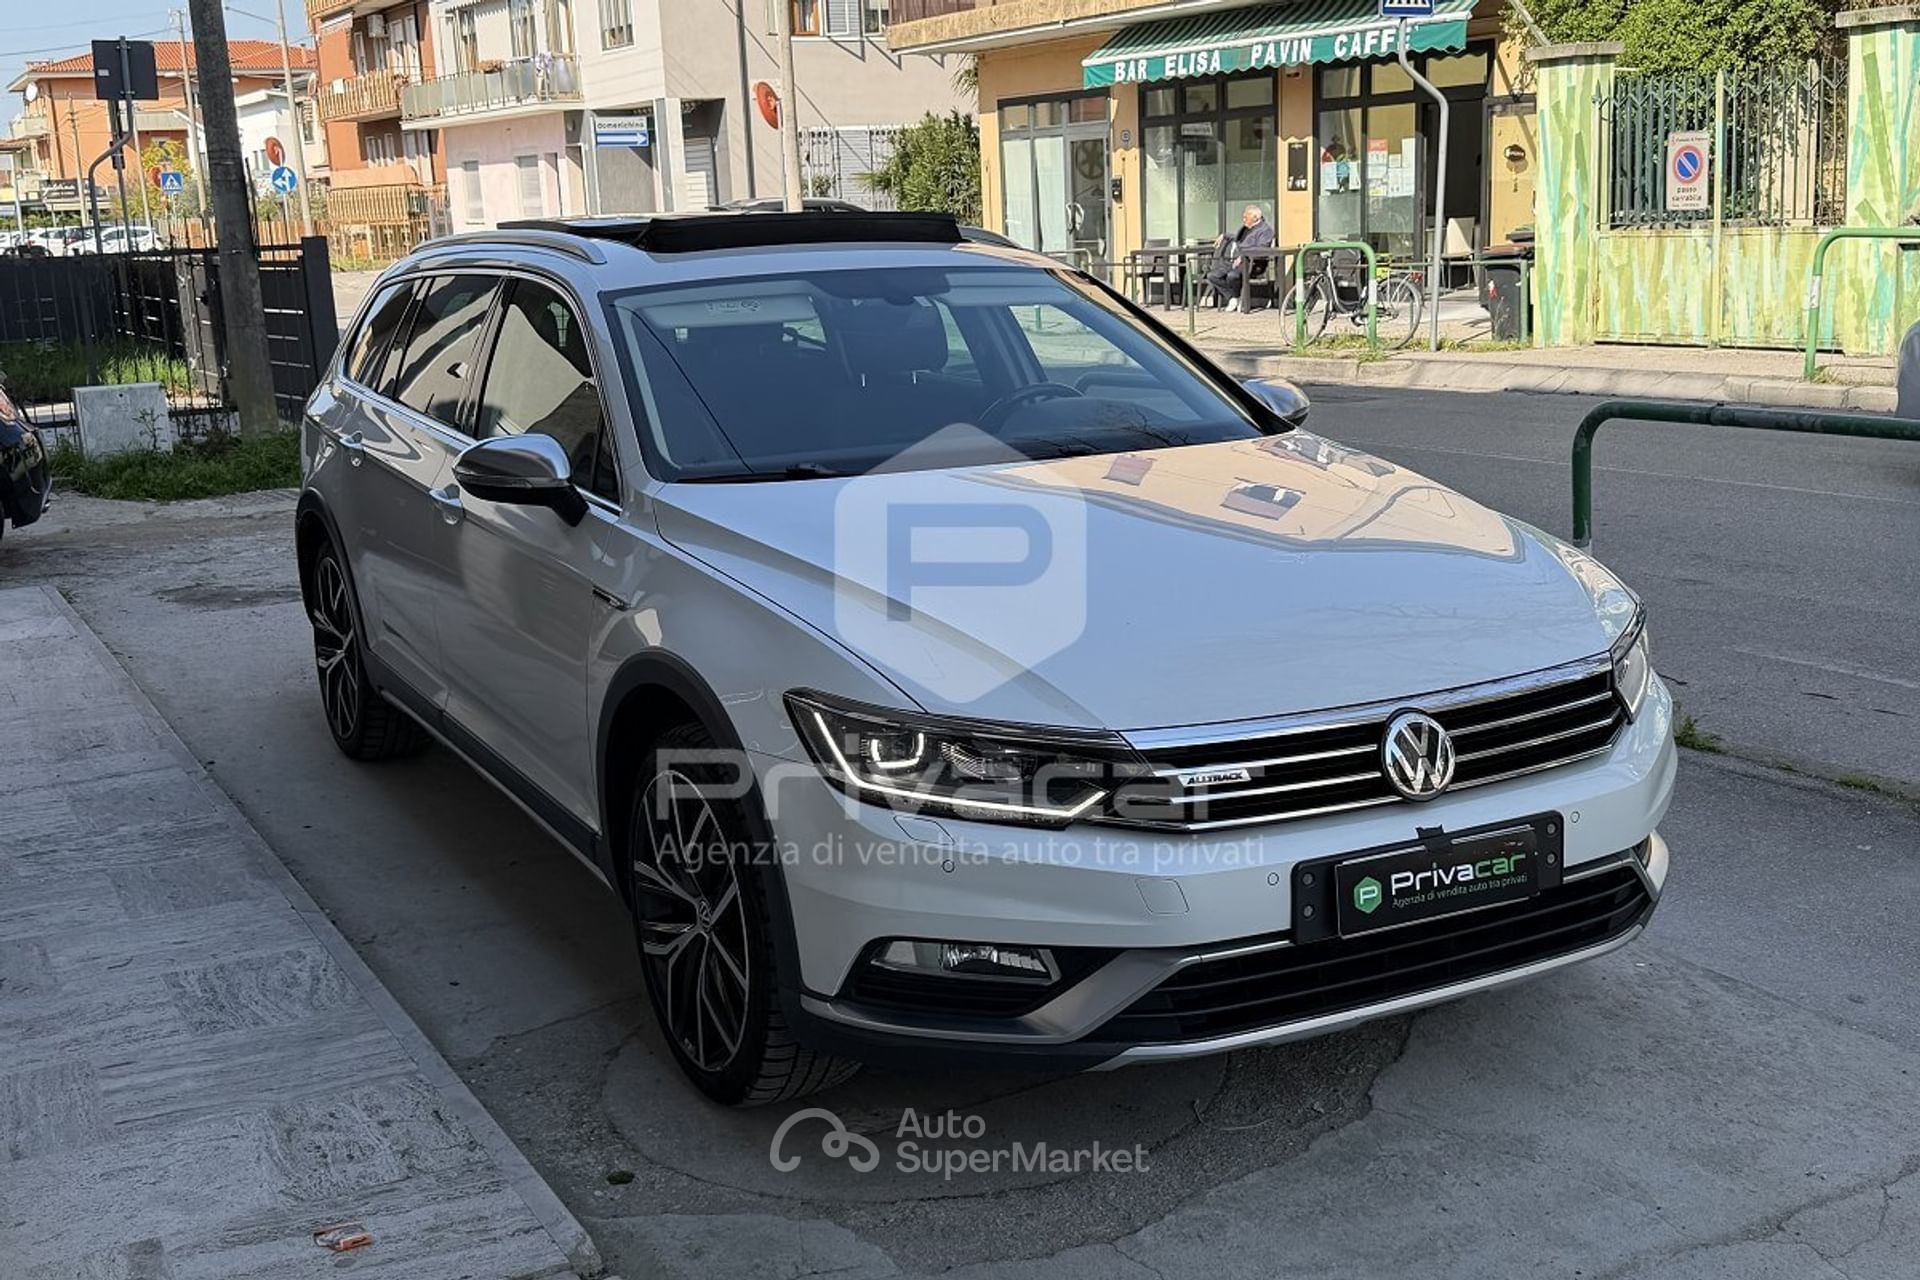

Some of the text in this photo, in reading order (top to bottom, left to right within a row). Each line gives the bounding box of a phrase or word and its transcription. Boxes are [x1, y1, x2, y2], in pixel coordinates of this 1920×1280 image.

[1114, 58, 1147, 82] BAR
[1165, 50, 1221, 76] ELISA
[1250, 38, 1312, 66] PAVIN
[1187, 771, 1243, 785] ALLTRACK
[1390, 854, 1526, 896] Privacar
[1392, 873, 1528, 909] Agenzia di vendita auto tra privati
